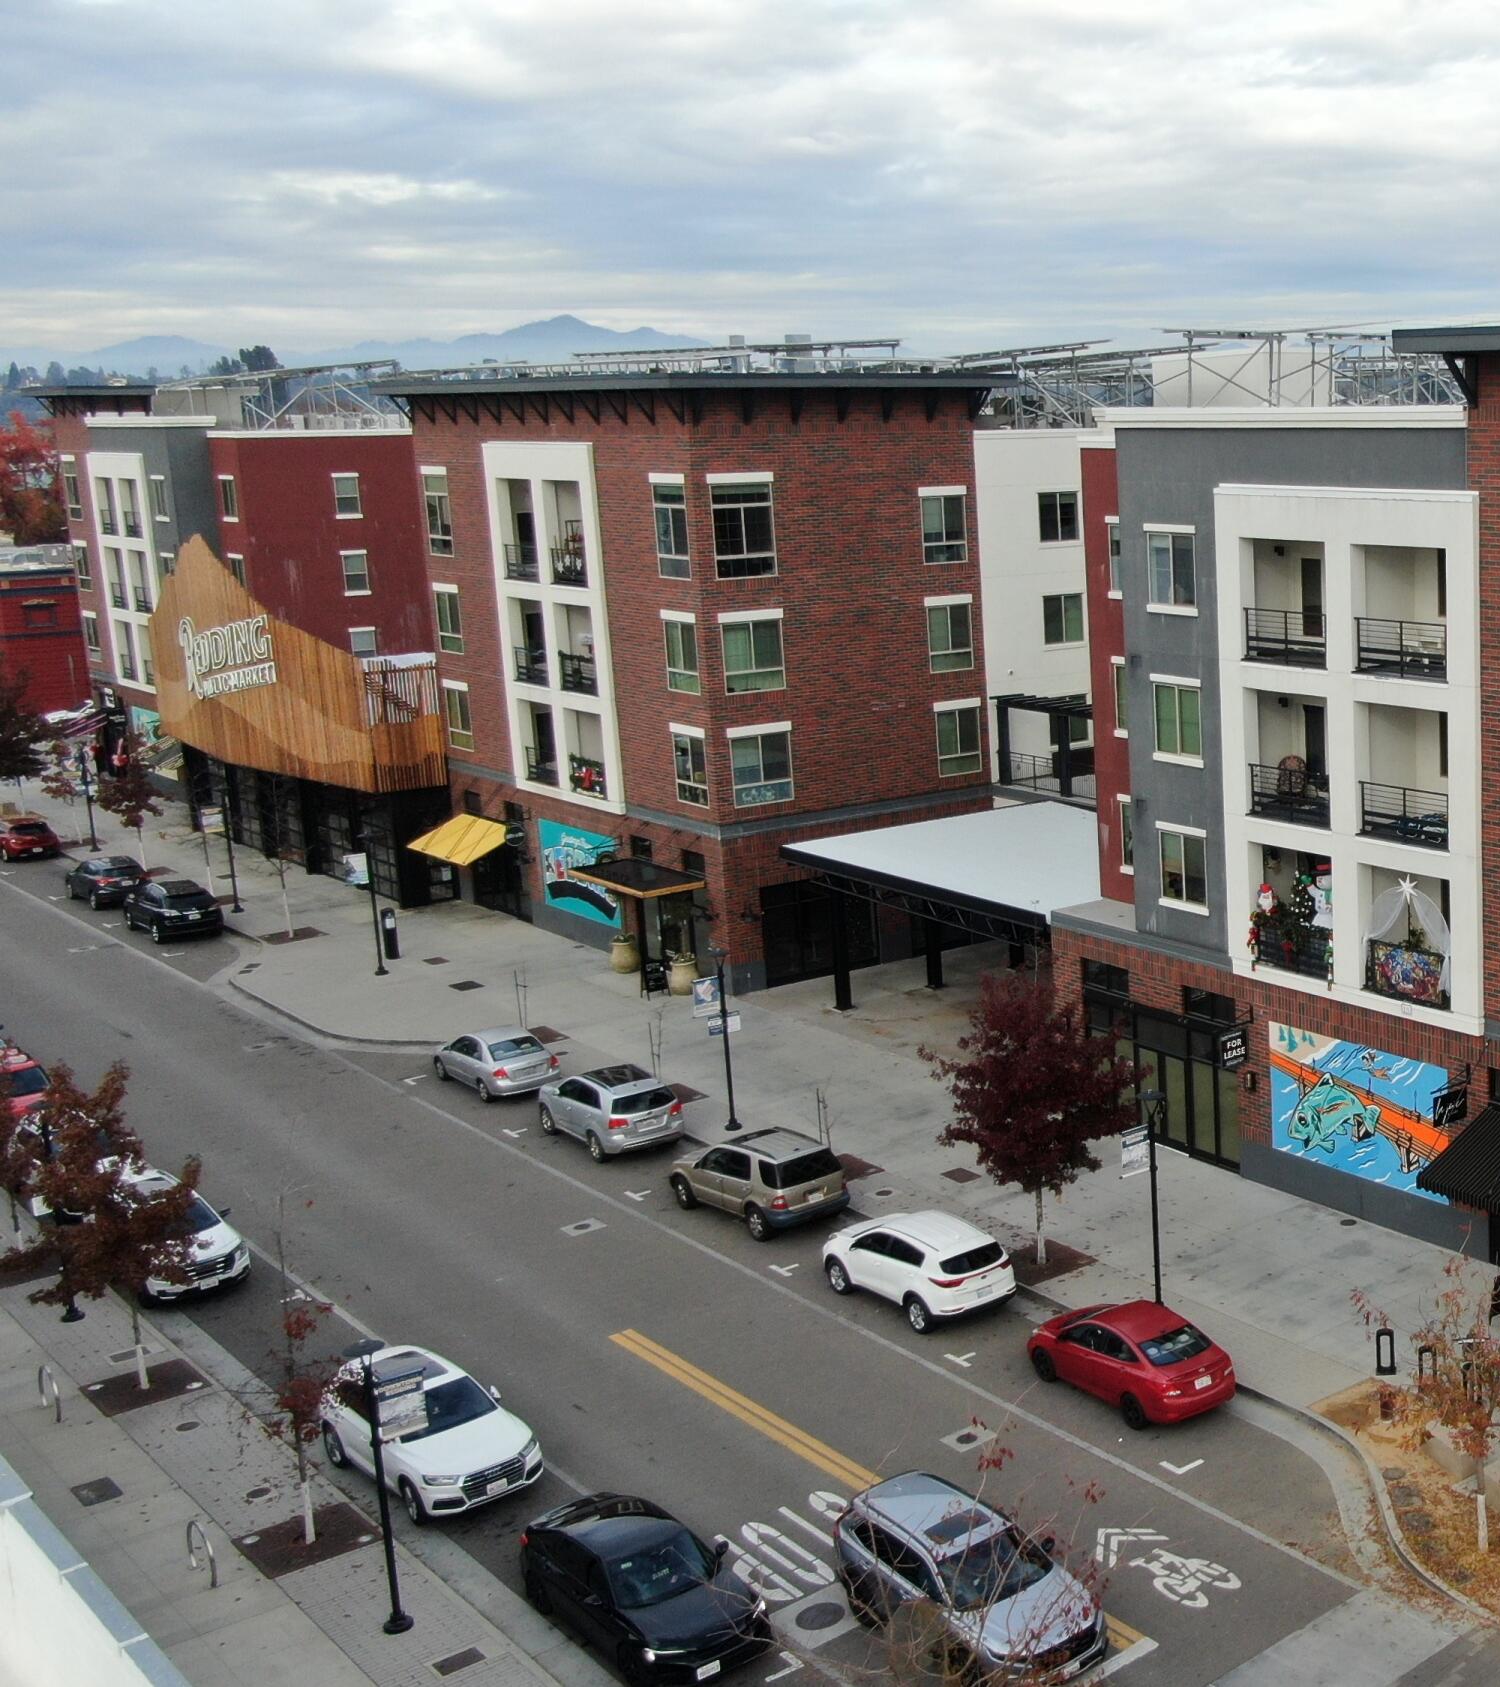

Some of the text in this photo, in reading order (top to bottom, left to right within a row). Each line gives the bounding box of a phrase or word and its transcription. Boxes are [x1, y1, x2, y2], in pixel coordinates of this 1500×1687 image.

[179, 614, 273, 700] REDDING
[231, 662, 277, 690] MARKET
[1223, 1046, 1246, 1060] LEASE
[1227, 1038, 1242, 1049] FOR
